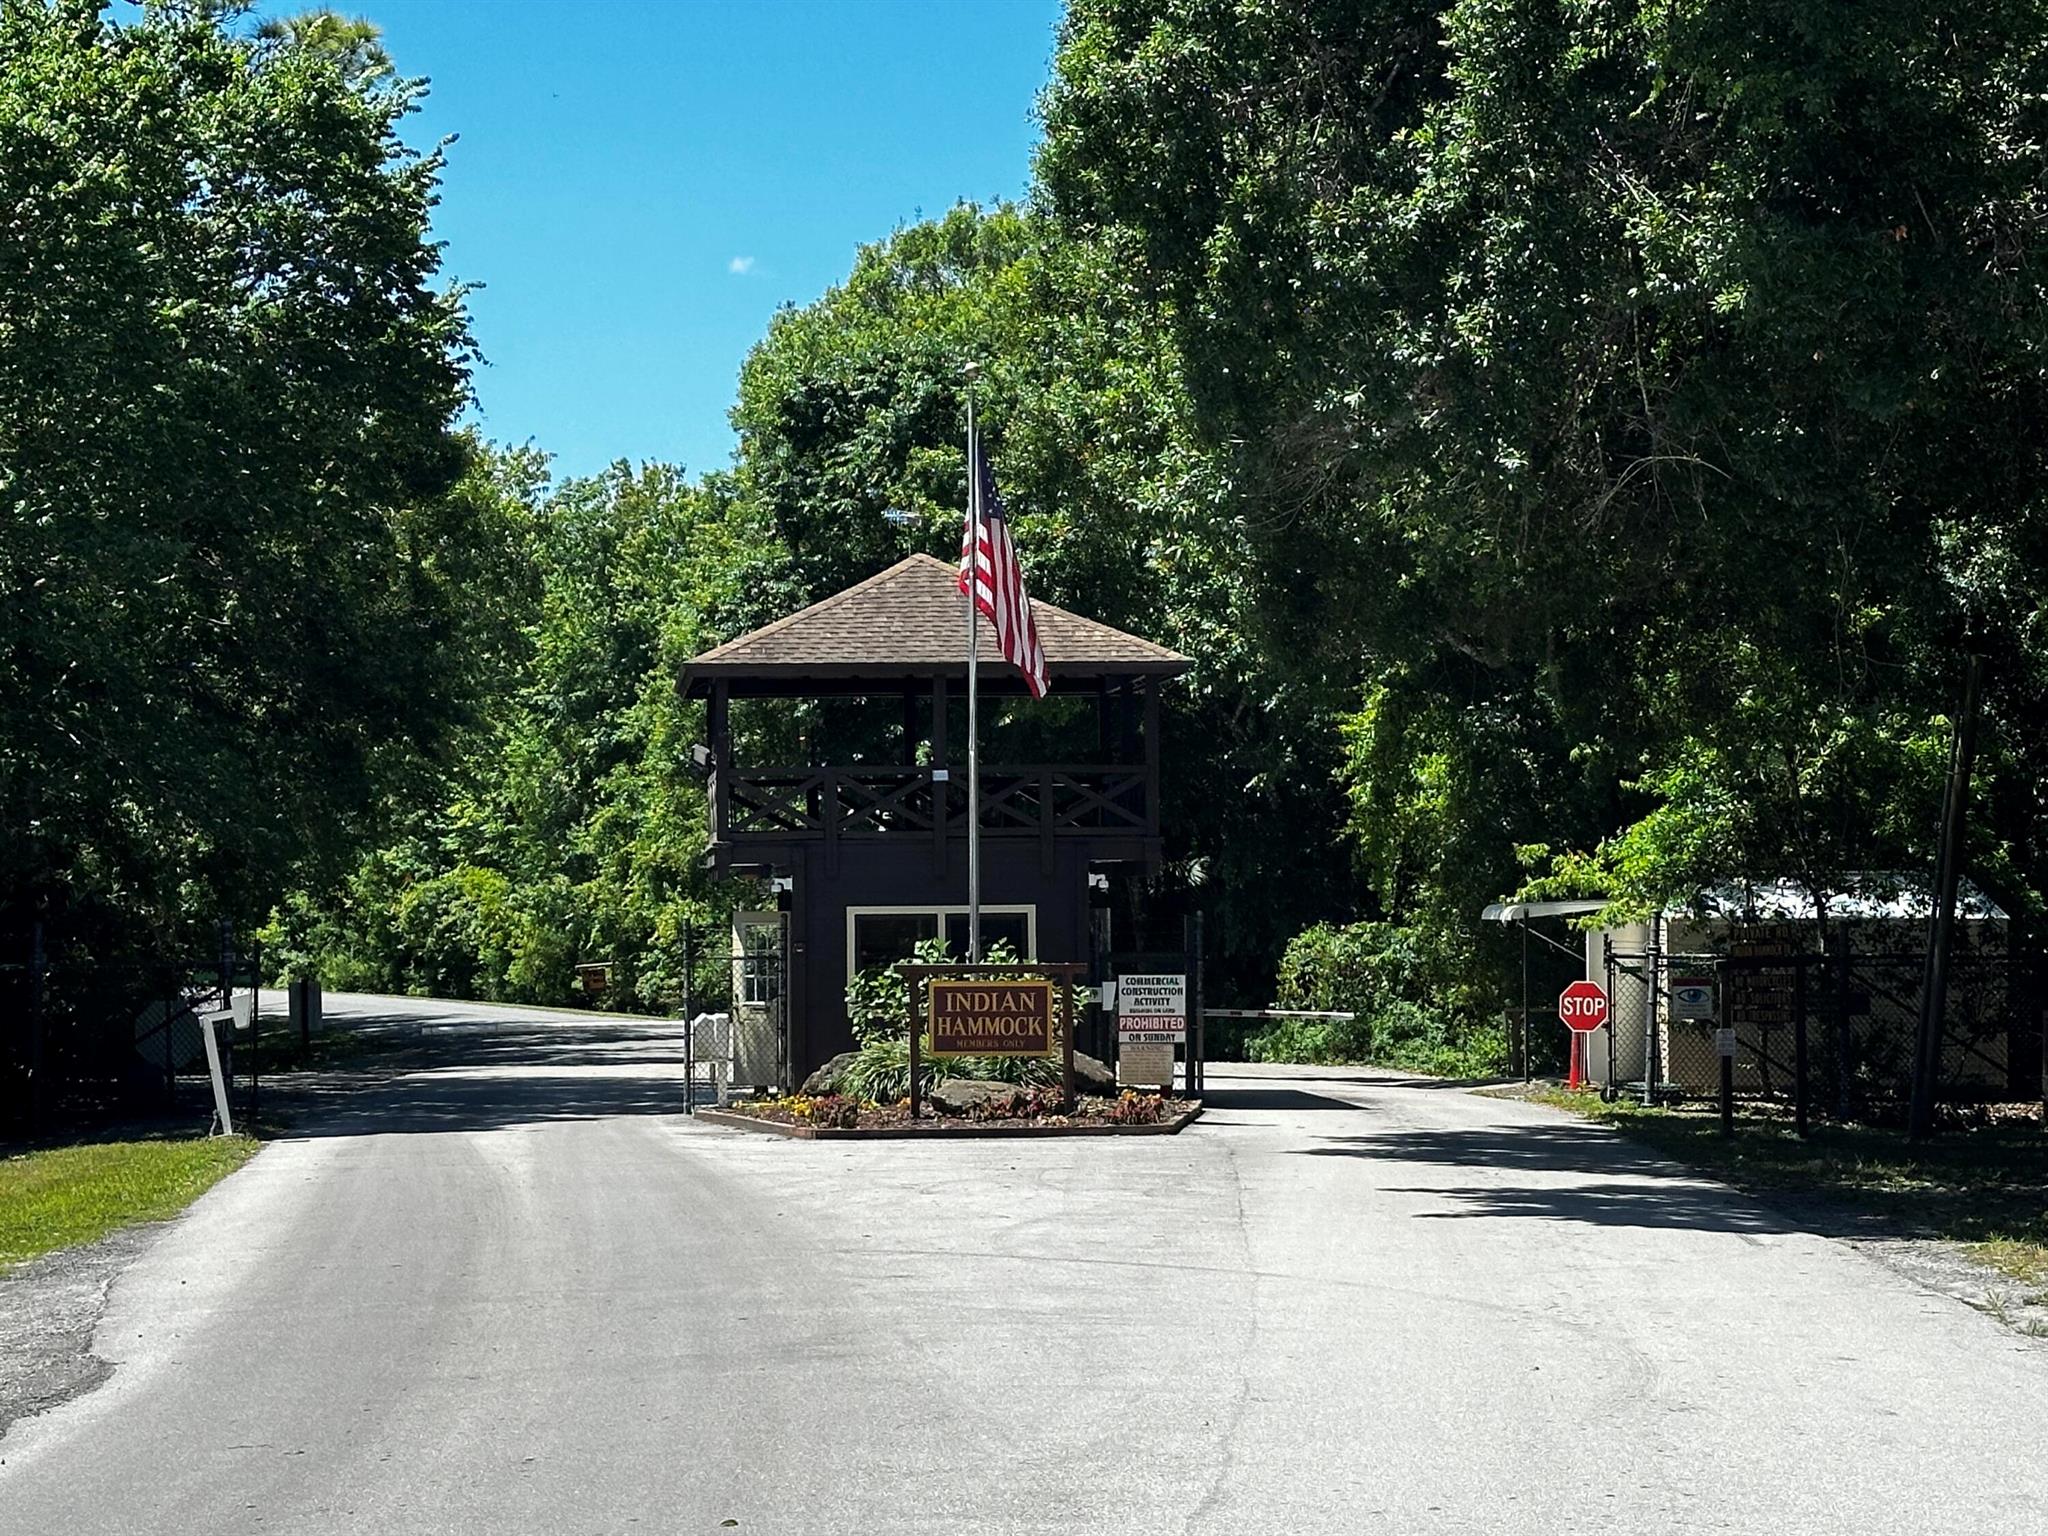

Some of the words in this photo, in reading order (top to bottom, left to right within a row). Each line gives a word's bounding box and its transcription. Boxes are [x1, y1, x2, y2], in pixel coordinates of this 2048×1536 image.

[1733, 927, 1772, 939] PRIVATE
[1125, 976, 1179, 985] COMMERCIAL
[1121, 987, 1183, 996] CONSTRUCTION
[945, 991, 1036, 1012] INDIAN
[1134, 997, 1171, 1006] ACTIVITY
[1563, 997, 1605, 1016] STOP
[937, 1016, 1044, 1036] HAMMOCK
[1119, 1017, 1185, 1030] PROHIBITED
[1128, 1033, 1142, 1041] ON
[1143, 1033, 1176, 1041] SUNDAY
[956, 1039, 999, 1048] MEMBERS
[1002, 1039, 1026, 1048] ONLY
